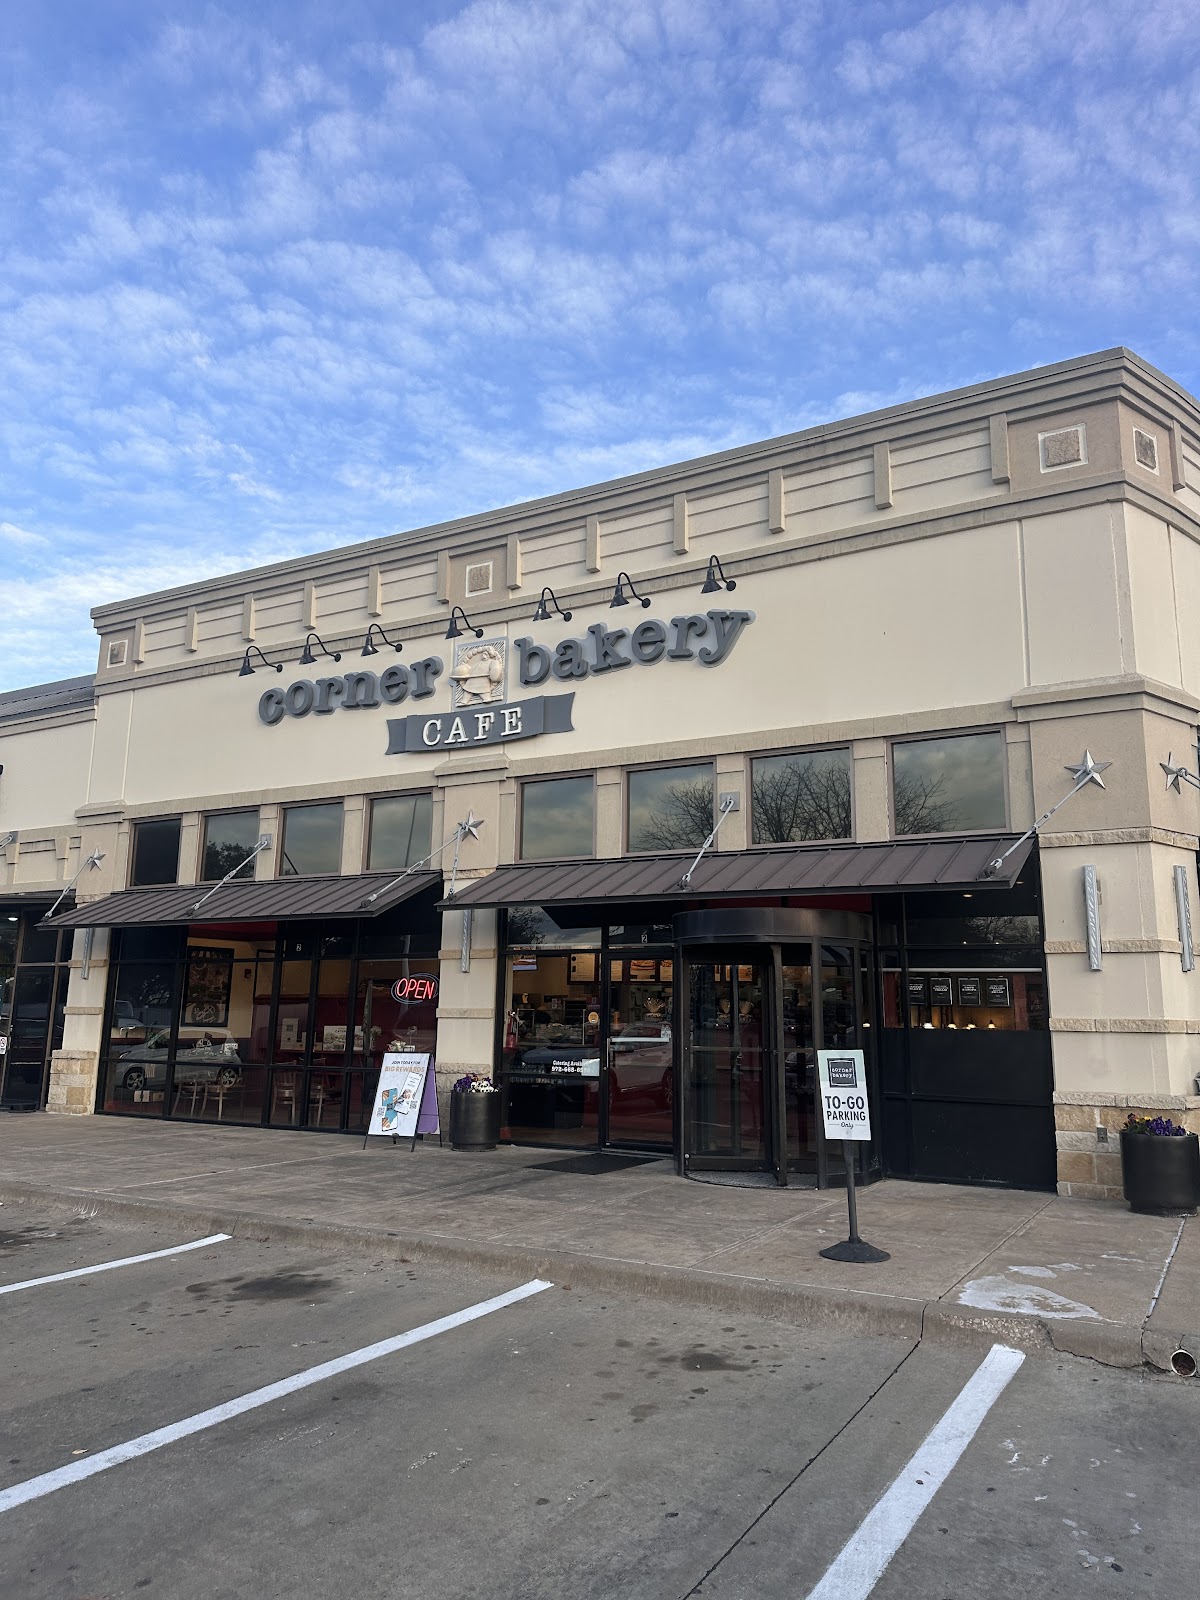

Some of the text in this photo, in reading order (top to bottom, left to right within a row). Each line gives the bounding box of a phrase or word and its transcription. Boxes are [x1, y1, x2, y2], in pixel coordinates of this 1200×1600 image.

[259, 609, 755, 725] corner bakery
[422, 707, 523, 746] CAFE
[397, 978, 435, 999] OPEN
[825, 1096, 864, 1109] TO-GO
[827, 1110, 866, 1121] PARKING
